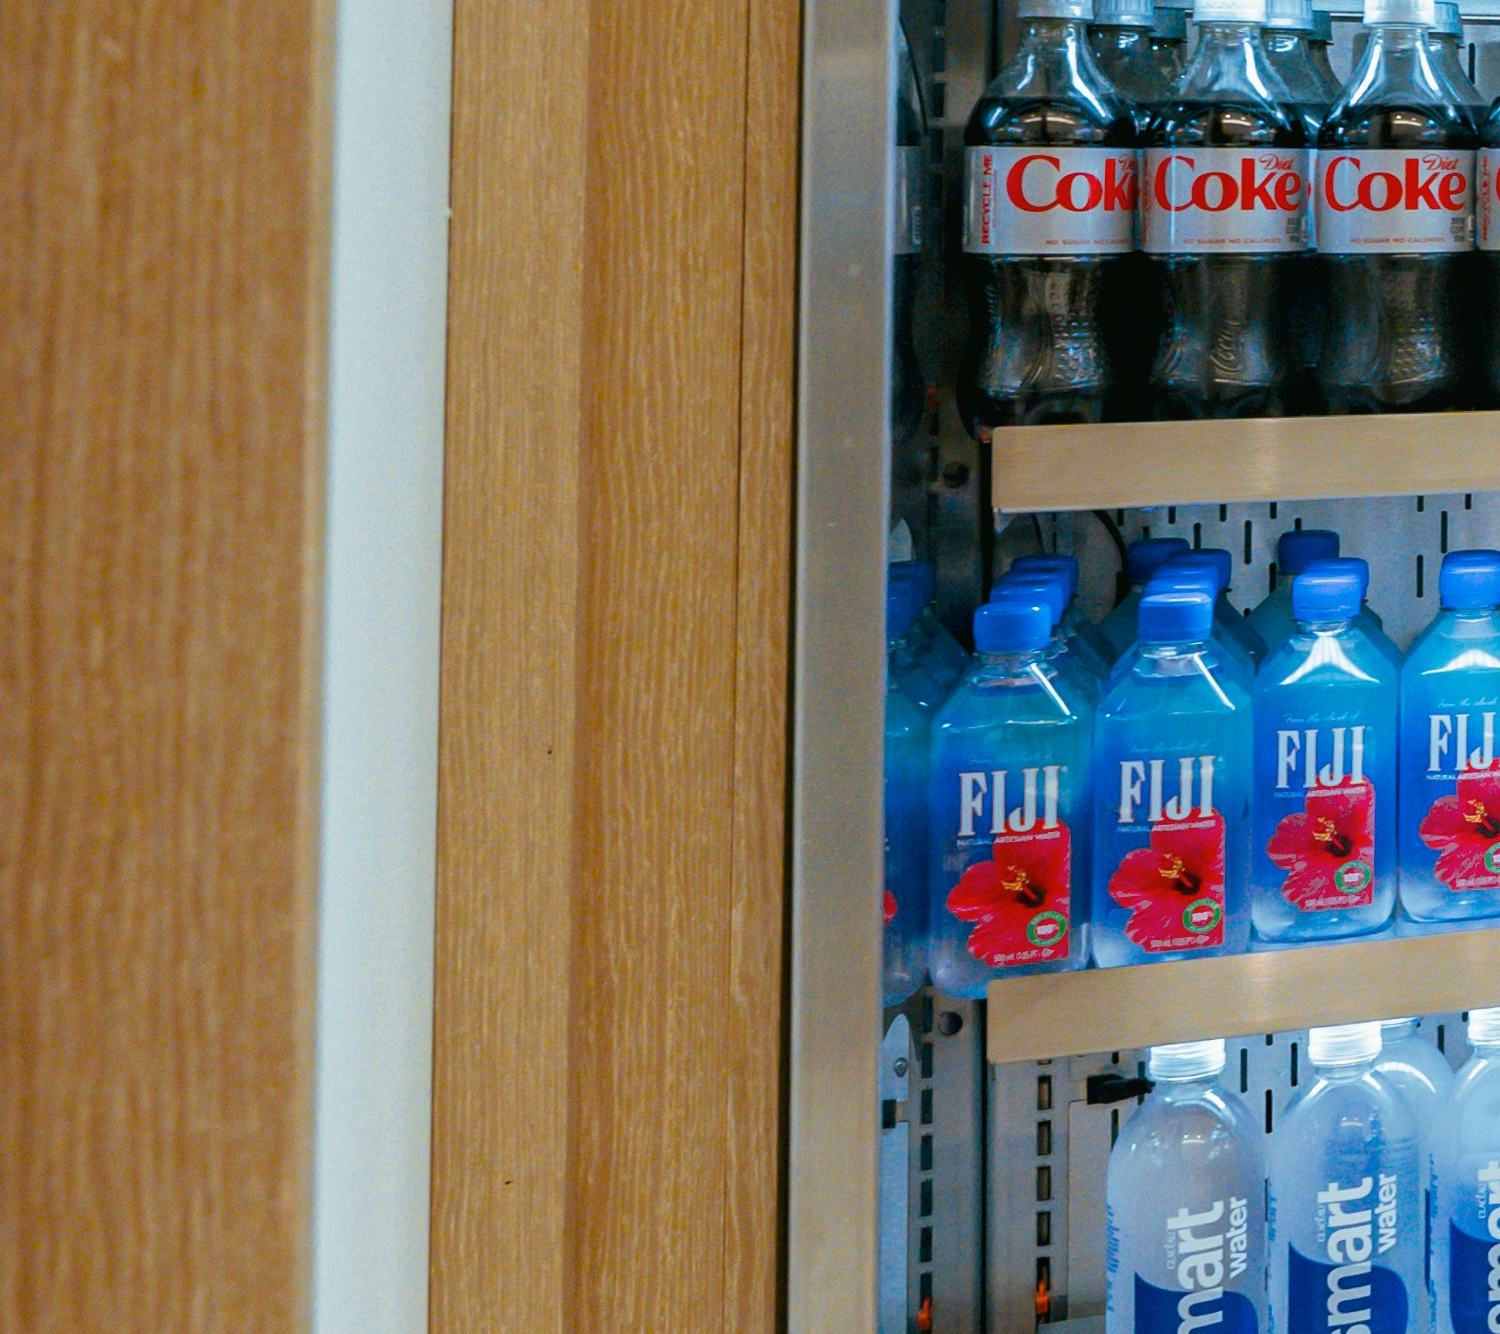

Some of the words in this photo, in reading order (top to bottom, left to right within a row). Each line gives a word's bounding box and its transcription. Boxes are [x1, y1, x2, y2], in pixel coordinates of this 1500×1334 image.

[982, 154, 993, 175] ME
[1006, 154, 1139, 213] Cok
[1154, 155, 1300, 212] Coke
[1259, 154, 1294, 170] Diet
[1325, 156, 1467, 212] Coke
[1422, 154, 1459, 170] Diet
[981, 178, 993, 244] RECYCLE
[1276, 725, 1365, 788] FIJI
[958, 766, 1060, 836] FIJI
[1118, 755, 1215, 823] FIJI
[1230, 1196, 1248, 1279] water
[1377, 1173, 1397, 1255] water
